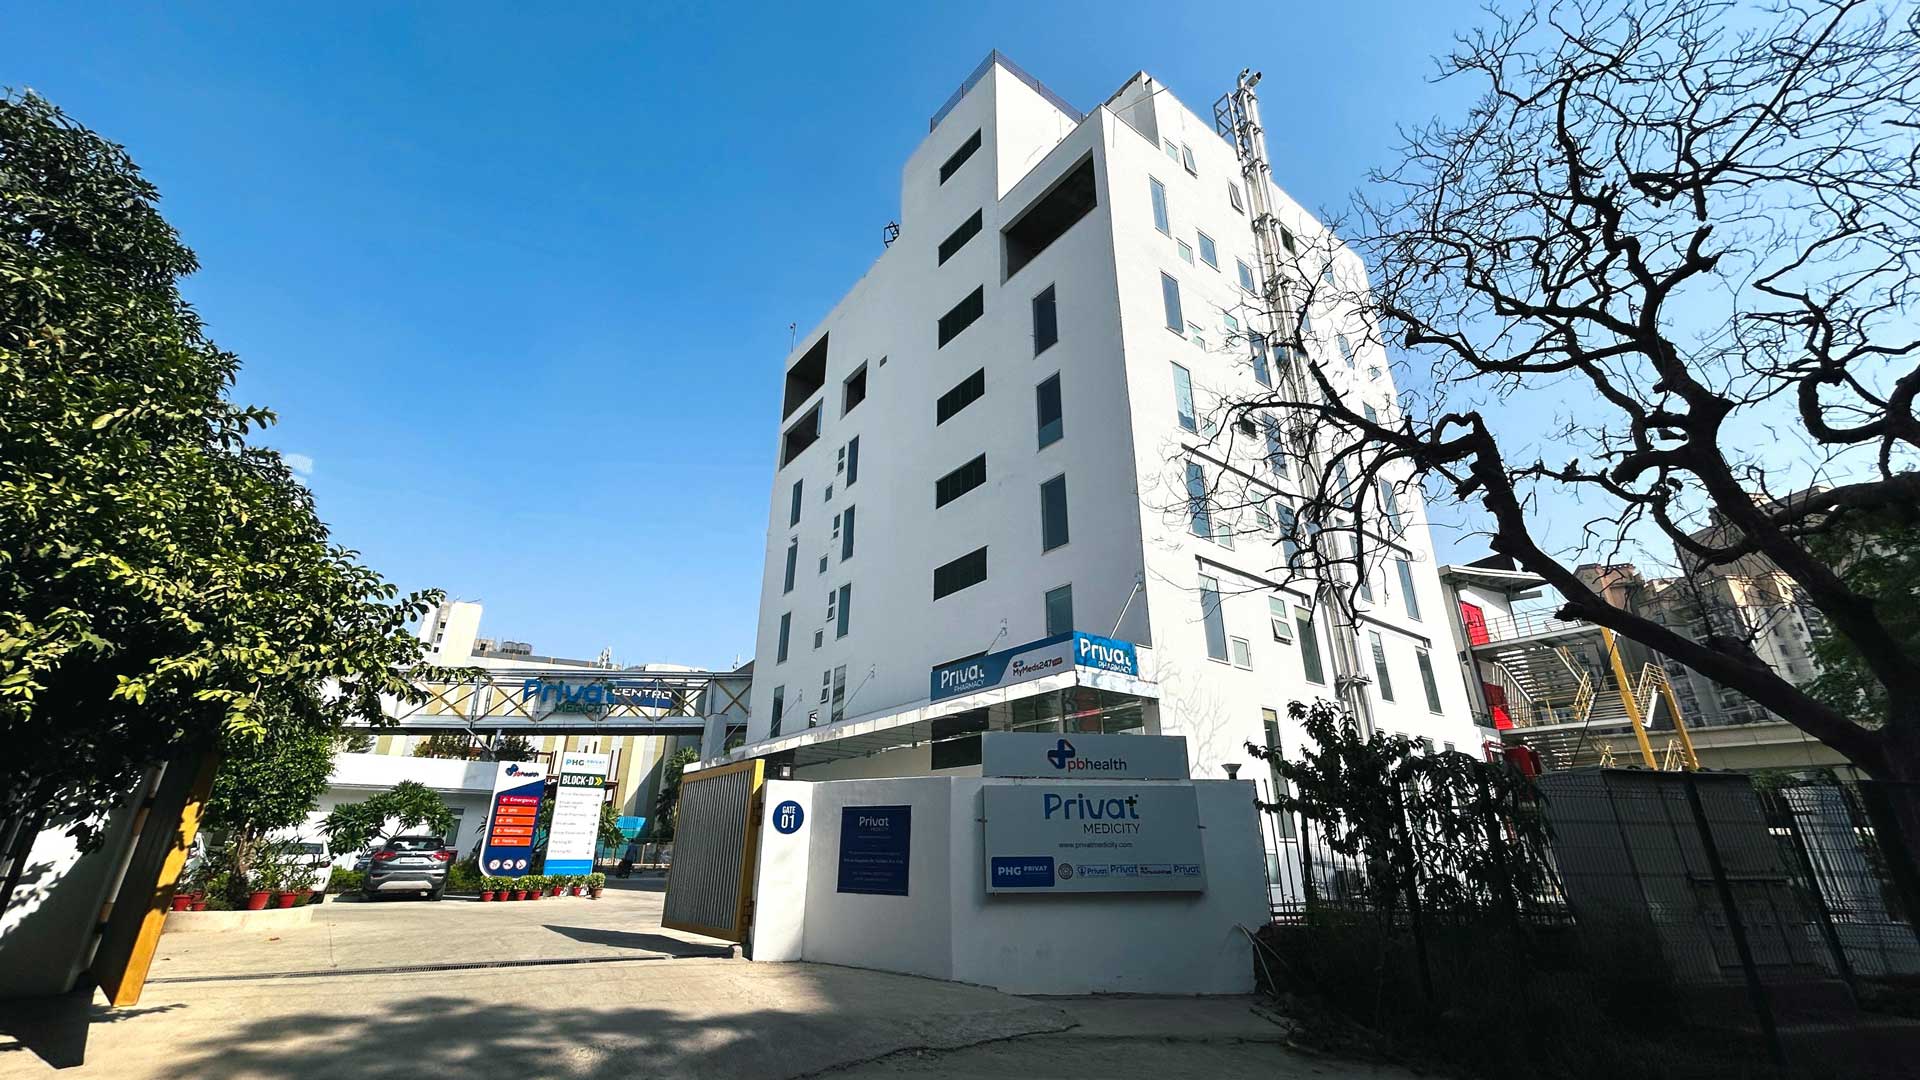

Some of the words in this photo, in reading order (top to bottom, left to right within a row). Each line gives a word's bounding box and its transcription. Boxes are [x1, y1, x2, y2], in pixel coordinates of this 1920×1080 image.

[1012, 659, 1052, 676] MyMeds247
[1097, 660, 1132, 674] PHARMACY
[953, 679, 985, 692] PHARMACY
[612, 688, 672, 700] CENTRO
[1067, 758, 1127, 772] pbhealth
[561, 775, 595, 786] BLOCK-D
[782, 806, 796, 814] GATE
[1044, 793, 1140, 820] Privat
[781, 814, 795, 829] 01
[859, 816, 889, 827] Privat
[1083, 823, 1141, 834] MEDICITY
[998, 866, 1022, 876] PHG
[1087, 867, 1107, 875] Privat
[1110, 864, 1138, 873] Privat
[1174, 865, 1200, 873] Privat
